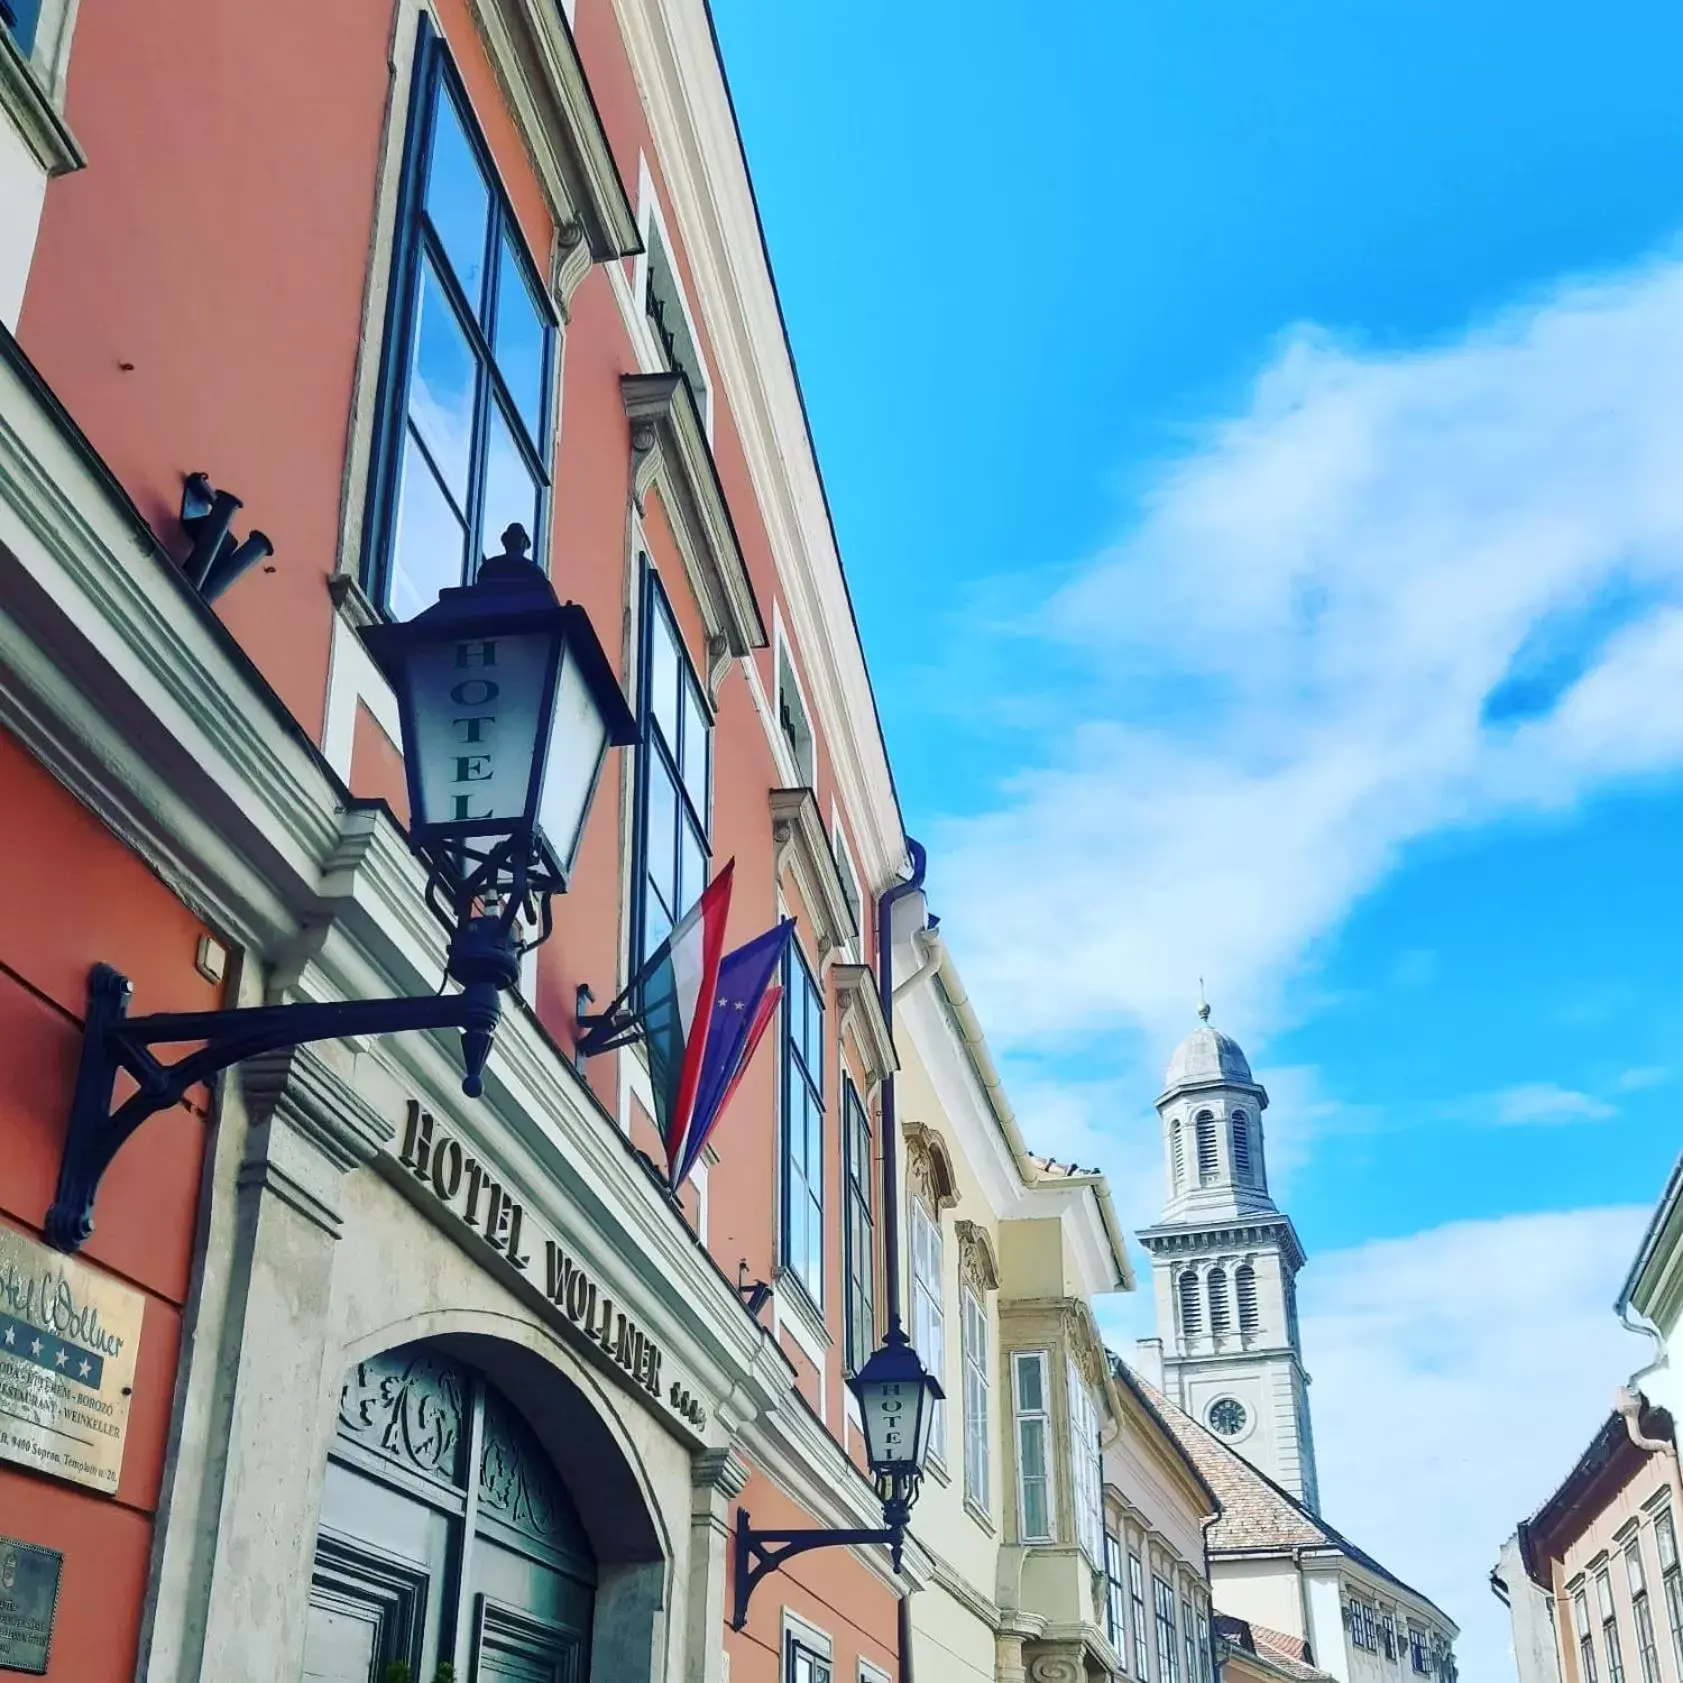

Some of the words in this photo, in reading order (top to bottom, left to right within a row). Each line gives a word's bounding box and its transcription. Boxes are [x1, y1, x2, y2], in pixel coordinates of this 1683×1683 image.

[450, 641, 499, 820] HOTEL
[398, 1099, 530, 1270] HOTEL
[545, 1240, 662, 1398] WOLLNER
[41, 1267, 124, 1358] Wollner
[64, 1407, 121, 1439] WEINKELLER
[881, 1384, 903, 1460] HOTEL
